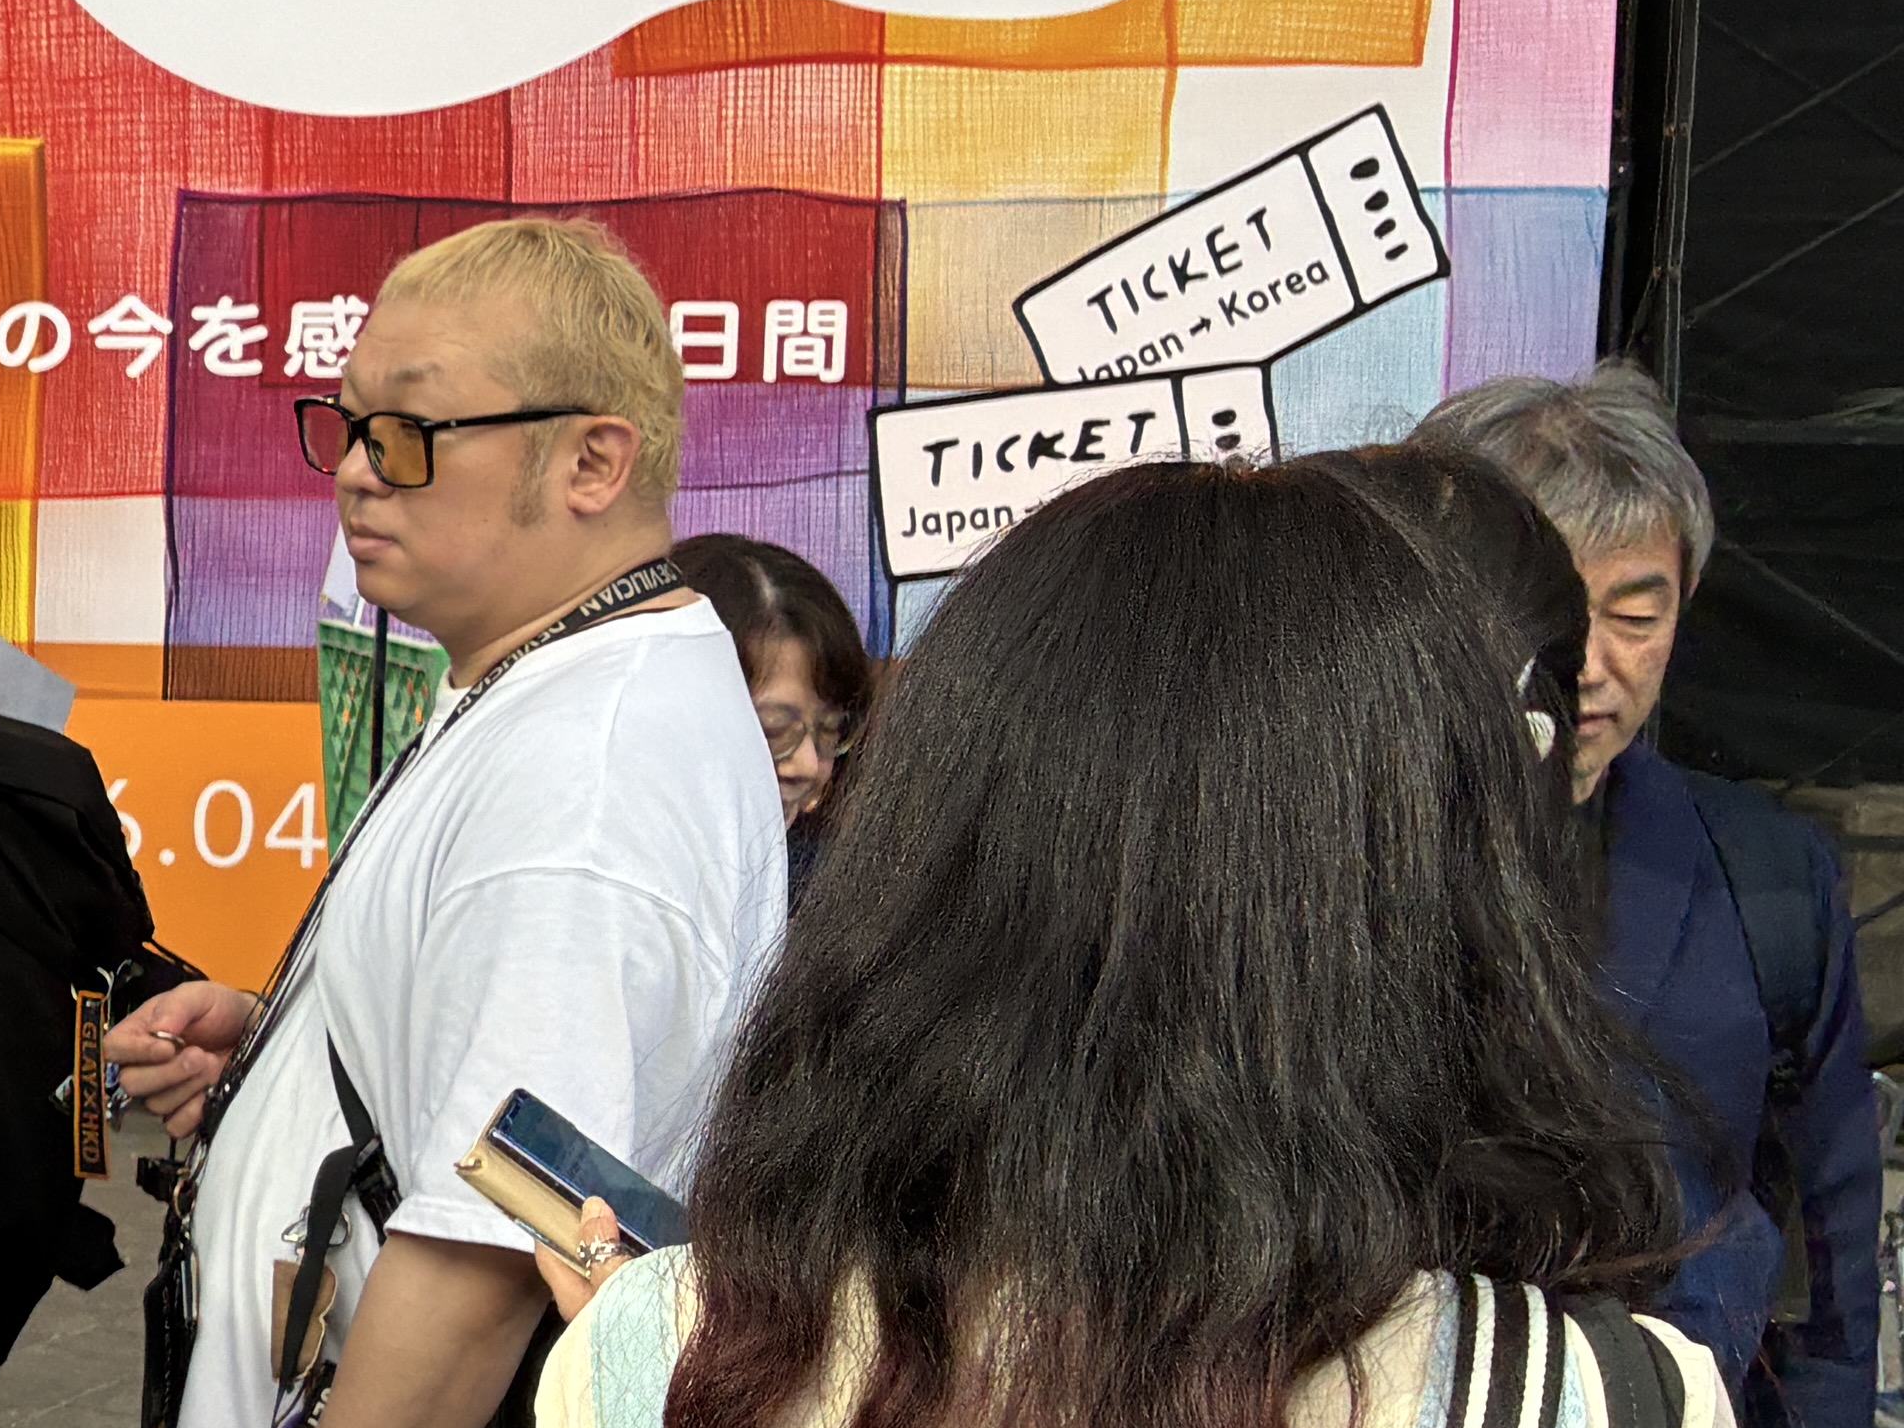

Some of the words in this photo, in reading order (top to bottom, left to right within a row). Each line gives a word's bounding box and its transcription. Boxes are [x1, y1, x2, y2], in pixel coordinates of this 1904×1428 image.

[1088, 206, 1283, 335] TICKET
[1218, 259, 1331, 328] Korea
[923, 410, 1157, 488] TICKET
[902, 503, 1015, 543] Japan
